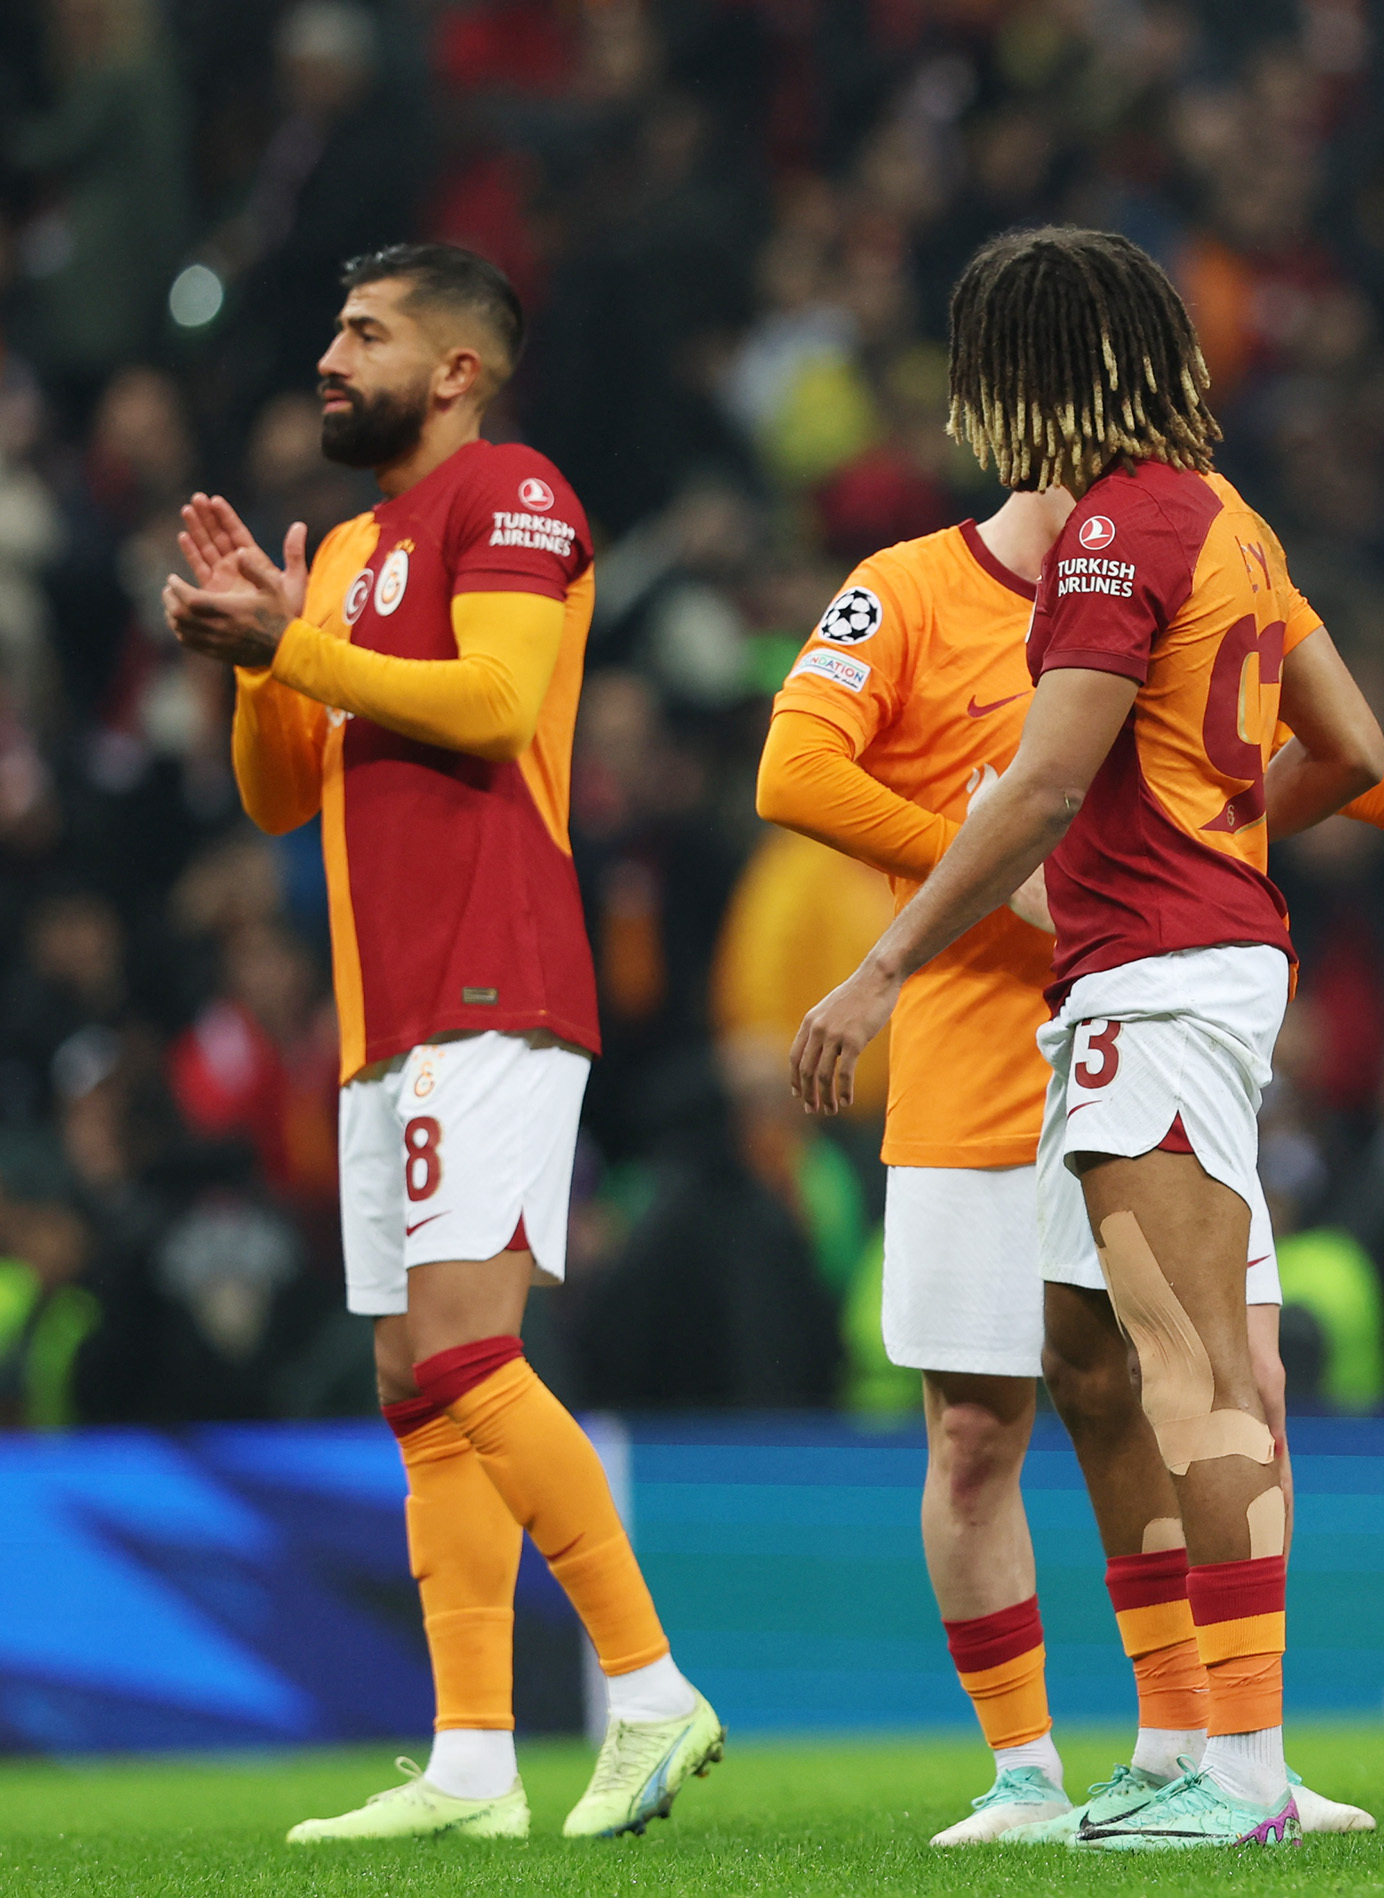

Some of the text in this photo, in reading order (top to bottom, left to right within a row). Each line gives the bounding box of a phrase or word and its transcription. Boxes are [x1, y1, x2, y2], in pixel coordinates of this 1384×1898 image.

[492, 512, 576, 540] TURKISH
[488, 529, 572, 557] AIRLINES
[1058, 558, 1136, 580] TURKISH
[1058, 577, 1134, 598] AIRLINES
[1074, 1018, 1123, 1090] 3
[404, 1116, 443, 1202] 8
